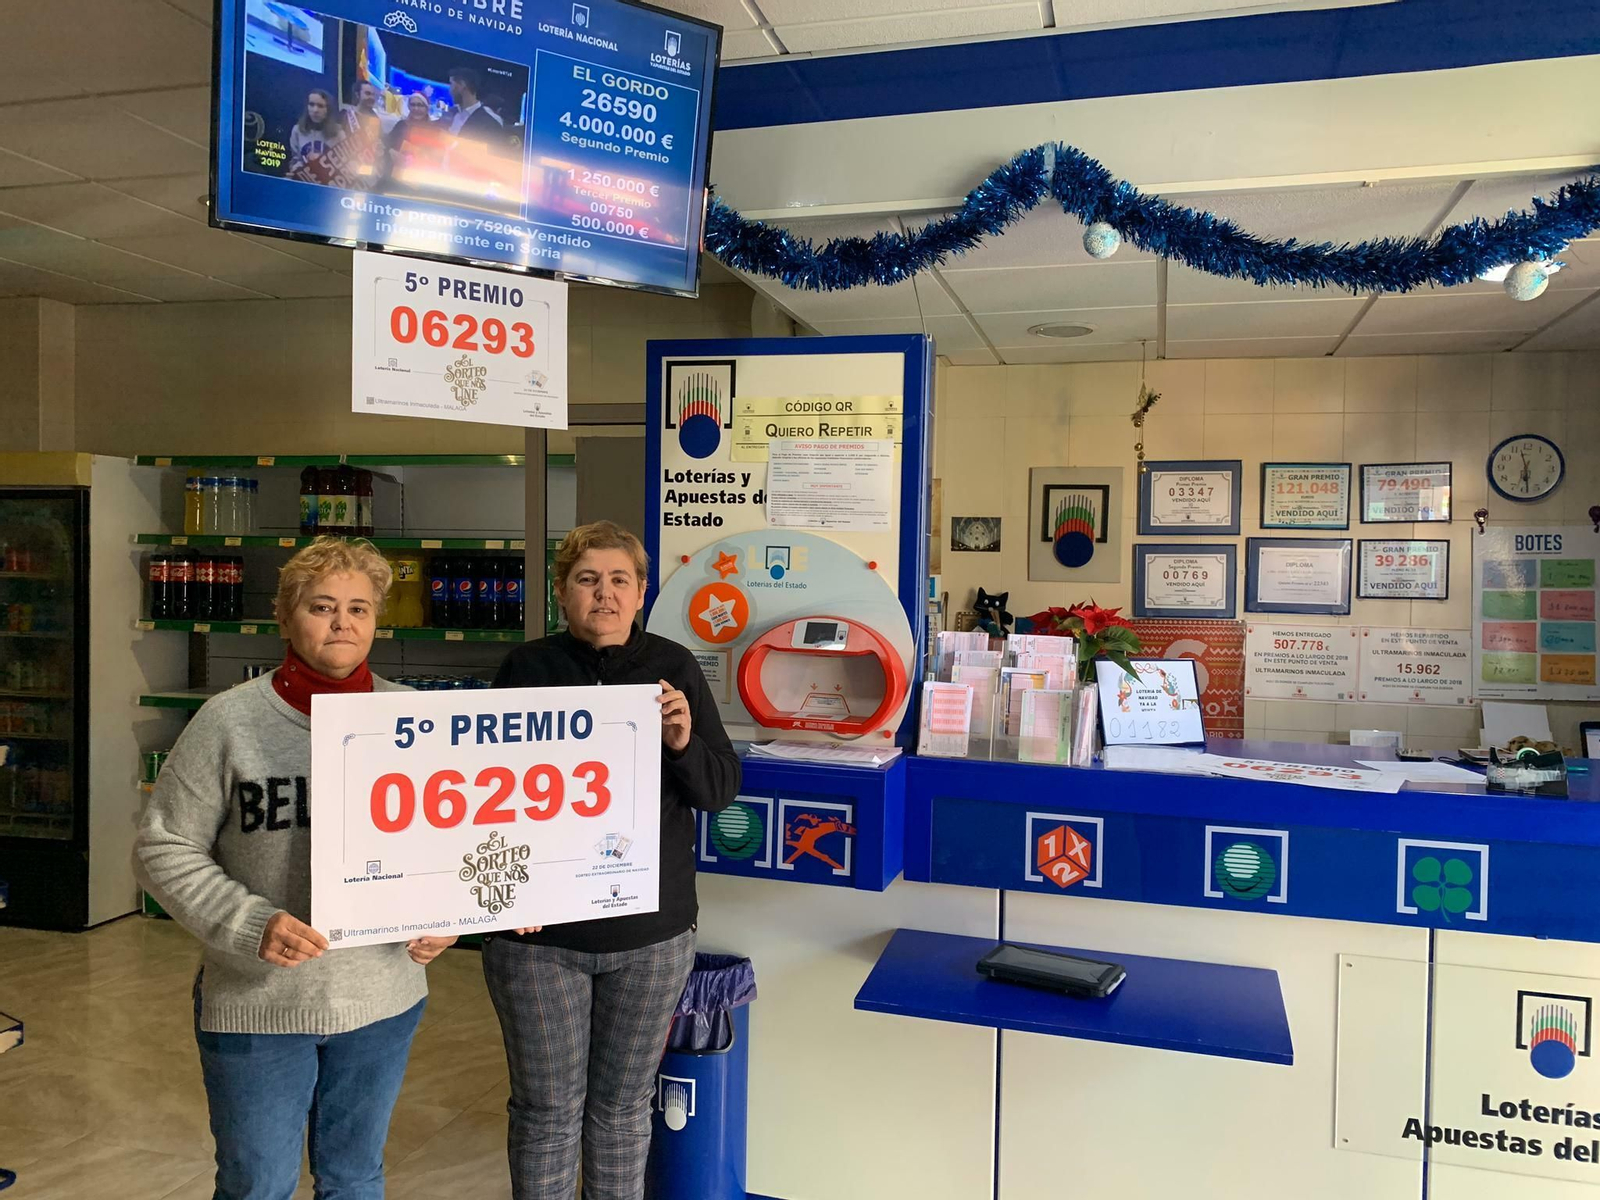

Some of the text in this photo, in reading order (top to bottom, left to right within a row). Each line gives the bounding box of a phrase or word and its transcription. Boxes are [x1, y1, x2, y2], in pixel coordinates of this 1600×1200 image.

[448, 8, 523, 36] DE NAVIDAD
[538, 22, 618, 52] LOTERÍA NACIONAL
[650, 53, 691, 71] LOTERÍAS
[573, 65, 669, 100] EL GORDO
[581, 89, 657, 122] 26590
[560, 112, 674, 150] 4.000.000 €
[255, 148, 286, 160] NAVIDAD
[561, 132, 669, 164] Segundo Premio
[261, 158, 280, 168] 2019
[568, 169, 660, 196] 1.250.000 €
[574, 186, 652, 208] Tercer Premio
[590, 202, 633, 218] 00750
[340, 197, 592, 249] Quinto premio 75206 Vendido
[572, 214, 649, 238] 500.000 €
[496, 241, 514, 252] en
[520, 244, 561, 260] Soria
[404, 272, 524, 308] 5º PREMIO
[390, 306, 535, 358] 06293
[454, 354, 473, 368] EL
[444, 365, 487, 383] SORTEO
[454, 378, 486, 391] QUE NOS
[450, 386, 478, 407] UNE
[786, 400, 853, 412] CÓDIGO QR
[664, 468, 751, 487] Loterías y
[1277, 482, 1339, 494] 121.048
[664, 490, 746, 508] Apuestas
[663, 512, 723, 527] Estado
[1317, 508, 1338, 518] AQUÍ
[1515, 534, 1562, 551] BOTES
[1375, 555, 1428, 566] 39.286
[1274, 639, 1323, 650] 507.778
[1397, 663, 1440, 675] 15.962
[394, 709, 594, 749] 5º PREMIO
[1110, 718, 1180, 740] 01182
[1223, 762, 1362, 780] 06293
[370, 760, 612, 834] 06293
[476, 830, 508, 855] EL
[459, 844, 531, 881] SORTEO
[372, 872, 404, 881] Nacional
[477, 863, 529, 888] QUE NOS
[470, 884, 516, 915] UNE
[343, 915, 497, 938] Ultramarinos Inmaculada MALAGA
[1402, 1118, 1599, 1164] Apuestas del
